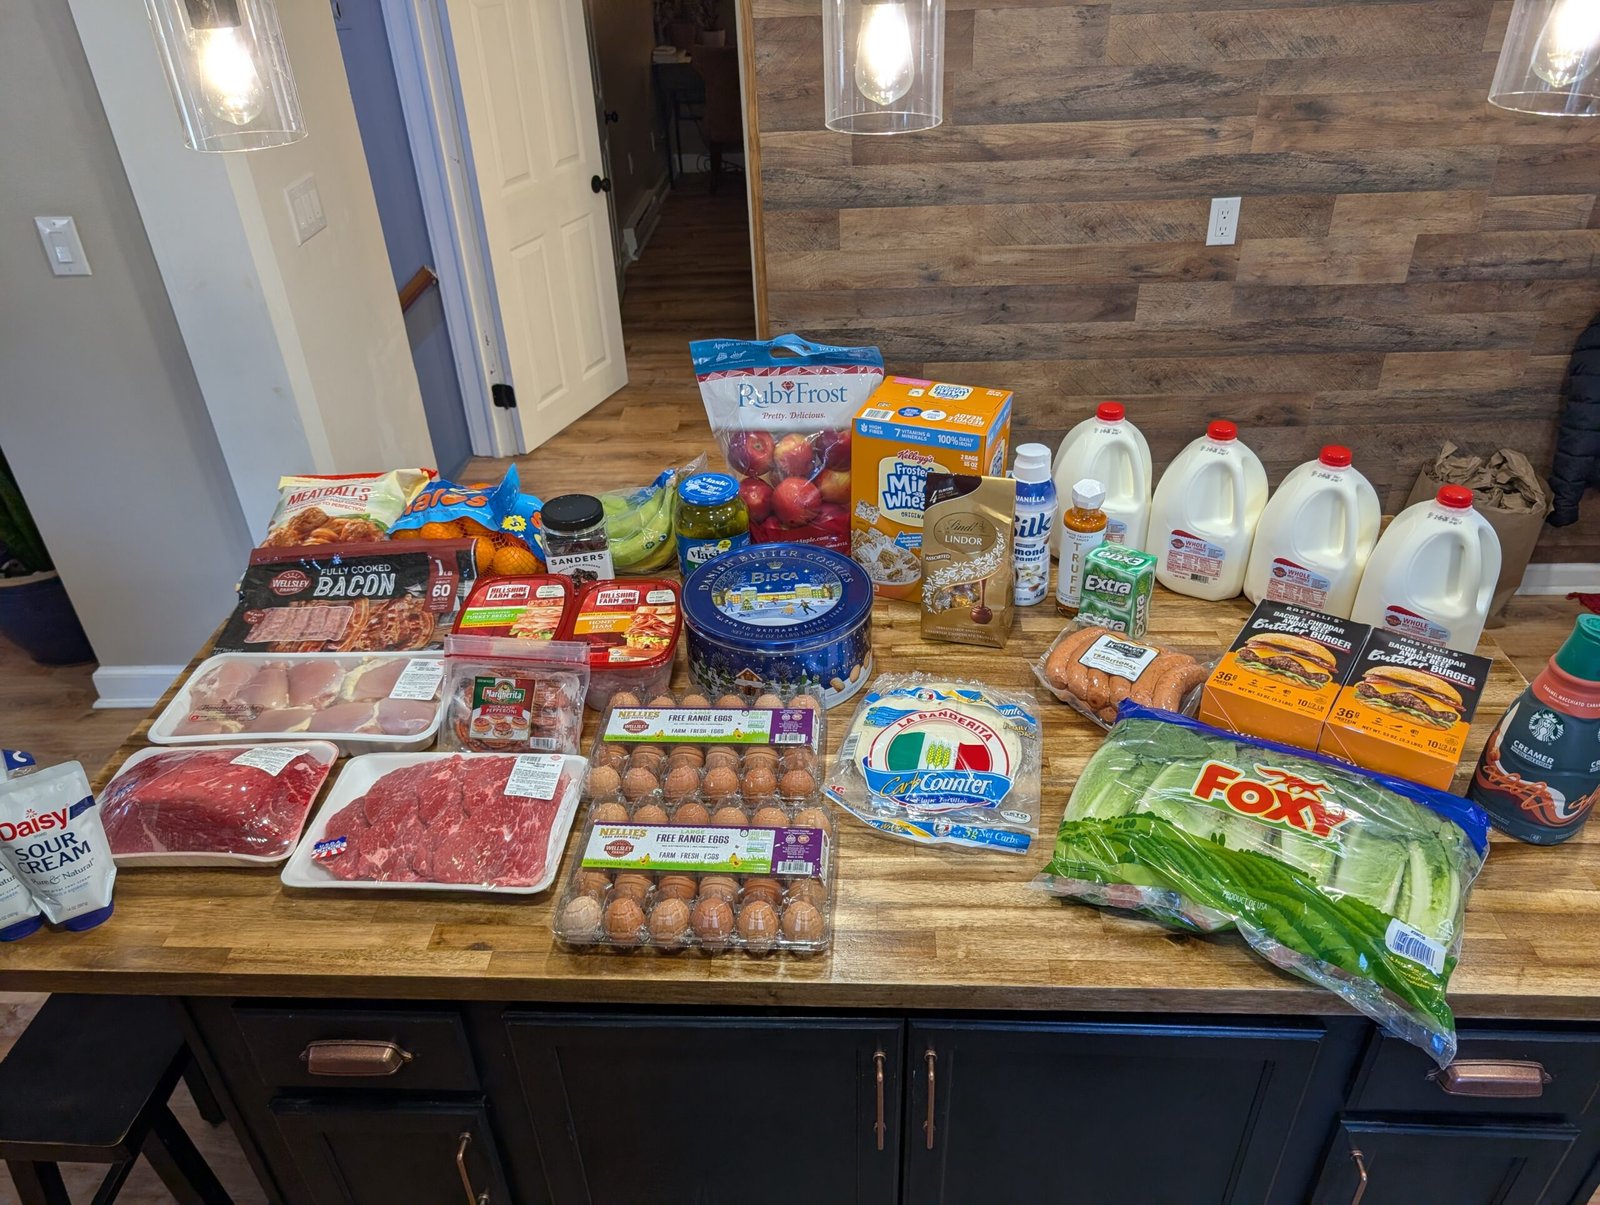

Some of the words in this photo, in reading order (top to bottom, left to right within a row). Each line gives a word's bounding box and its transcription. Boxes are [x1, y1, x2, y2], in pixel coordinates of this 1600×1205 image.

[762, 412, 787, 421] Pretty.
[789, 411, 826, 420] Delicious.
[894, 428, 901, 438] 7
[937, 434, 959, 446] 100%
[897, 450, 934, 465] Kellogg's
[929, 489, 938, 504] 4
[944, 535, 983, 546] LINDOR
[1185, 541, 1207, 549] WHOLE
[551, 553, 604, 566] SANDERS
[1097, 551, 1145, 566] Extra
[321, 568, 349, 576] FULLY
[351, 564, 392, 574] COOKED
[698, 559, 735, 592] DANISH
[739, 550, 798, 563] BUTTER
[806, 552, 854, 584] COOKIES
[1287, 569, 1310, 579] WHOLE
[272, 579, 310, 589] WELLSLEY
[313, 573, 396, 597] BACON
[431, 584, 452, 597] 60
[490, 586, 528, 594] HILLSHIRE
[1084, 574, 1132, 595] Extra
[1135, 594, 1146, 637] Extra
[1273, 611, 1301, 621] BACON
[1307, 619, 1345, 635] CHEDDAR
[1403, 617, 1429, 629] WHOLE
[1252, 618, 1309, 636] Butcher
[1310, 631, 1352, 650] BURGER
[1282, 618, 1309, 629] ANGUS
[1309, 624, 1331, 635] BEEF
[1093, 653, 1137, 671] TRADITIONAL
[1388, 641, 1417, 653] BACON
[1426, 652, 1467, 669] CHEDDAR
[1398, 650, 1428, 662] ANGUS
[1428, 658, 1451, 668] BEEF
[1367, 649, 1428, 669] Butcher
[1430, 665, 1476, 685] BURGER
[485, 689, 522, 700] Margherita
[1297, 698, 1308, 707] 10
[1542, 684, 1558, 698] CARAMEL
[1558, 696, 1585, 707] MACCHIATO
[668, 714, 686, 722] FREE
[687, 714, 712, 722] RANGE
[897, 717, 915, 729] LA
[918, 710, 994, 742] BANDERITA
[1427, 740, 1439, 749] 10
[1513, 739, 1555, 765] CREAMER
[880, 772, 921, 798] Carb
[920, 773, 992, 796] Counter
[1193, 763, 1349, 838] FOXY
[0, 807, 67, 842] Daisy
[655, 833, 677, 843] FREE
[678, 834, 706, 844] RANGE
[707, 835, 730, 844] EGGS
[979, 829, 994, 840] Net
[994, 831, 1019, 845] Carbs
[14, 831, 79, 862] SOUR
[17, 839, 92, 875] CREAM
[658, 851, 676, 859] FARM
[680, 852, 700, 860] FRESH
[49, 874, 61, 885] &
[62, 859, 93, 880] Natural
[1221, 890, 1249, 906] PRODUCT
